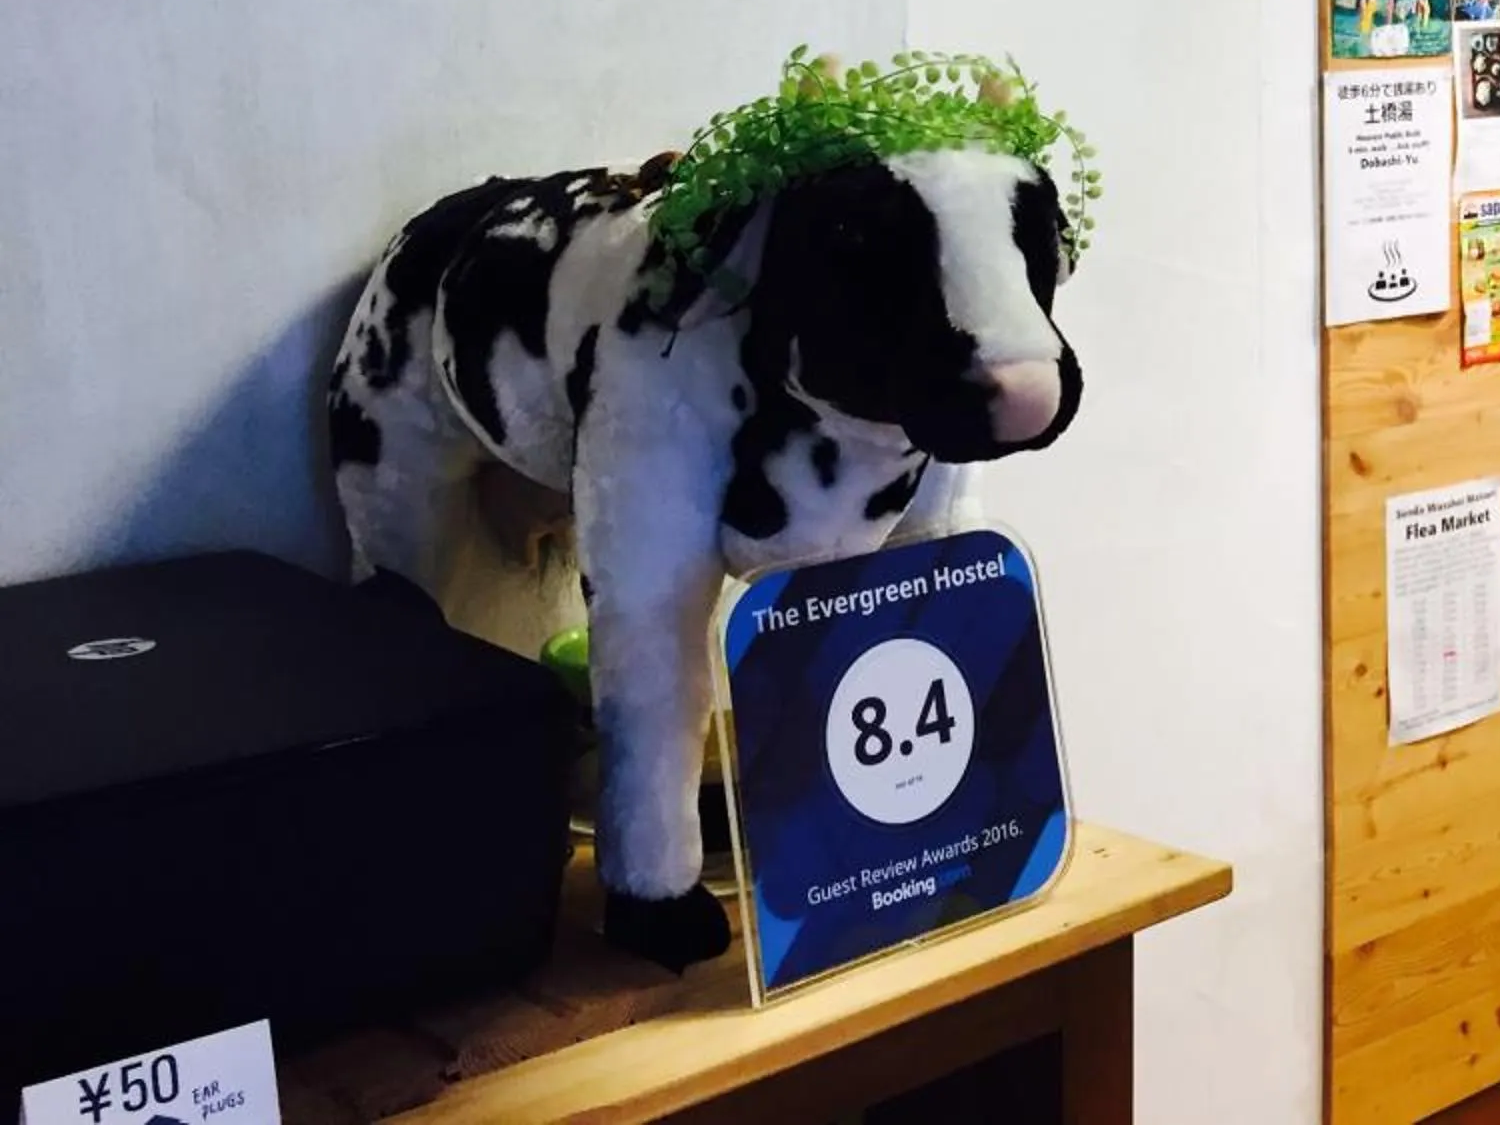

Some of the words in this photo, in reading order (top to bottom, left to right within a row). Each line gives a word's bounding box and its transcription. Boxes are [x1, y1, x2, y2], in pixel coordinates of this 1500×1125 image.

[1405, 522, 1437, 541] Flea
[1441, 508, 1491, 533] Market
[752, 606, 800, 635] The
[806, 573, 930, 623] Evergreen
[933, 553, 1007, 593] Hostel
[850, 677, 957, 768] 8.4
[807, 877, 858, 906] Guest
[860, 853, 918, 888] Review
[921, 837, 979, 868] Awards
[981, 818, 1024, 848] 2016.
[77, 1053, 181, 1124] ¥50
[192, 1080, 221, 1106] EAR
[202, 1090, 246, 1121] PLUGS
